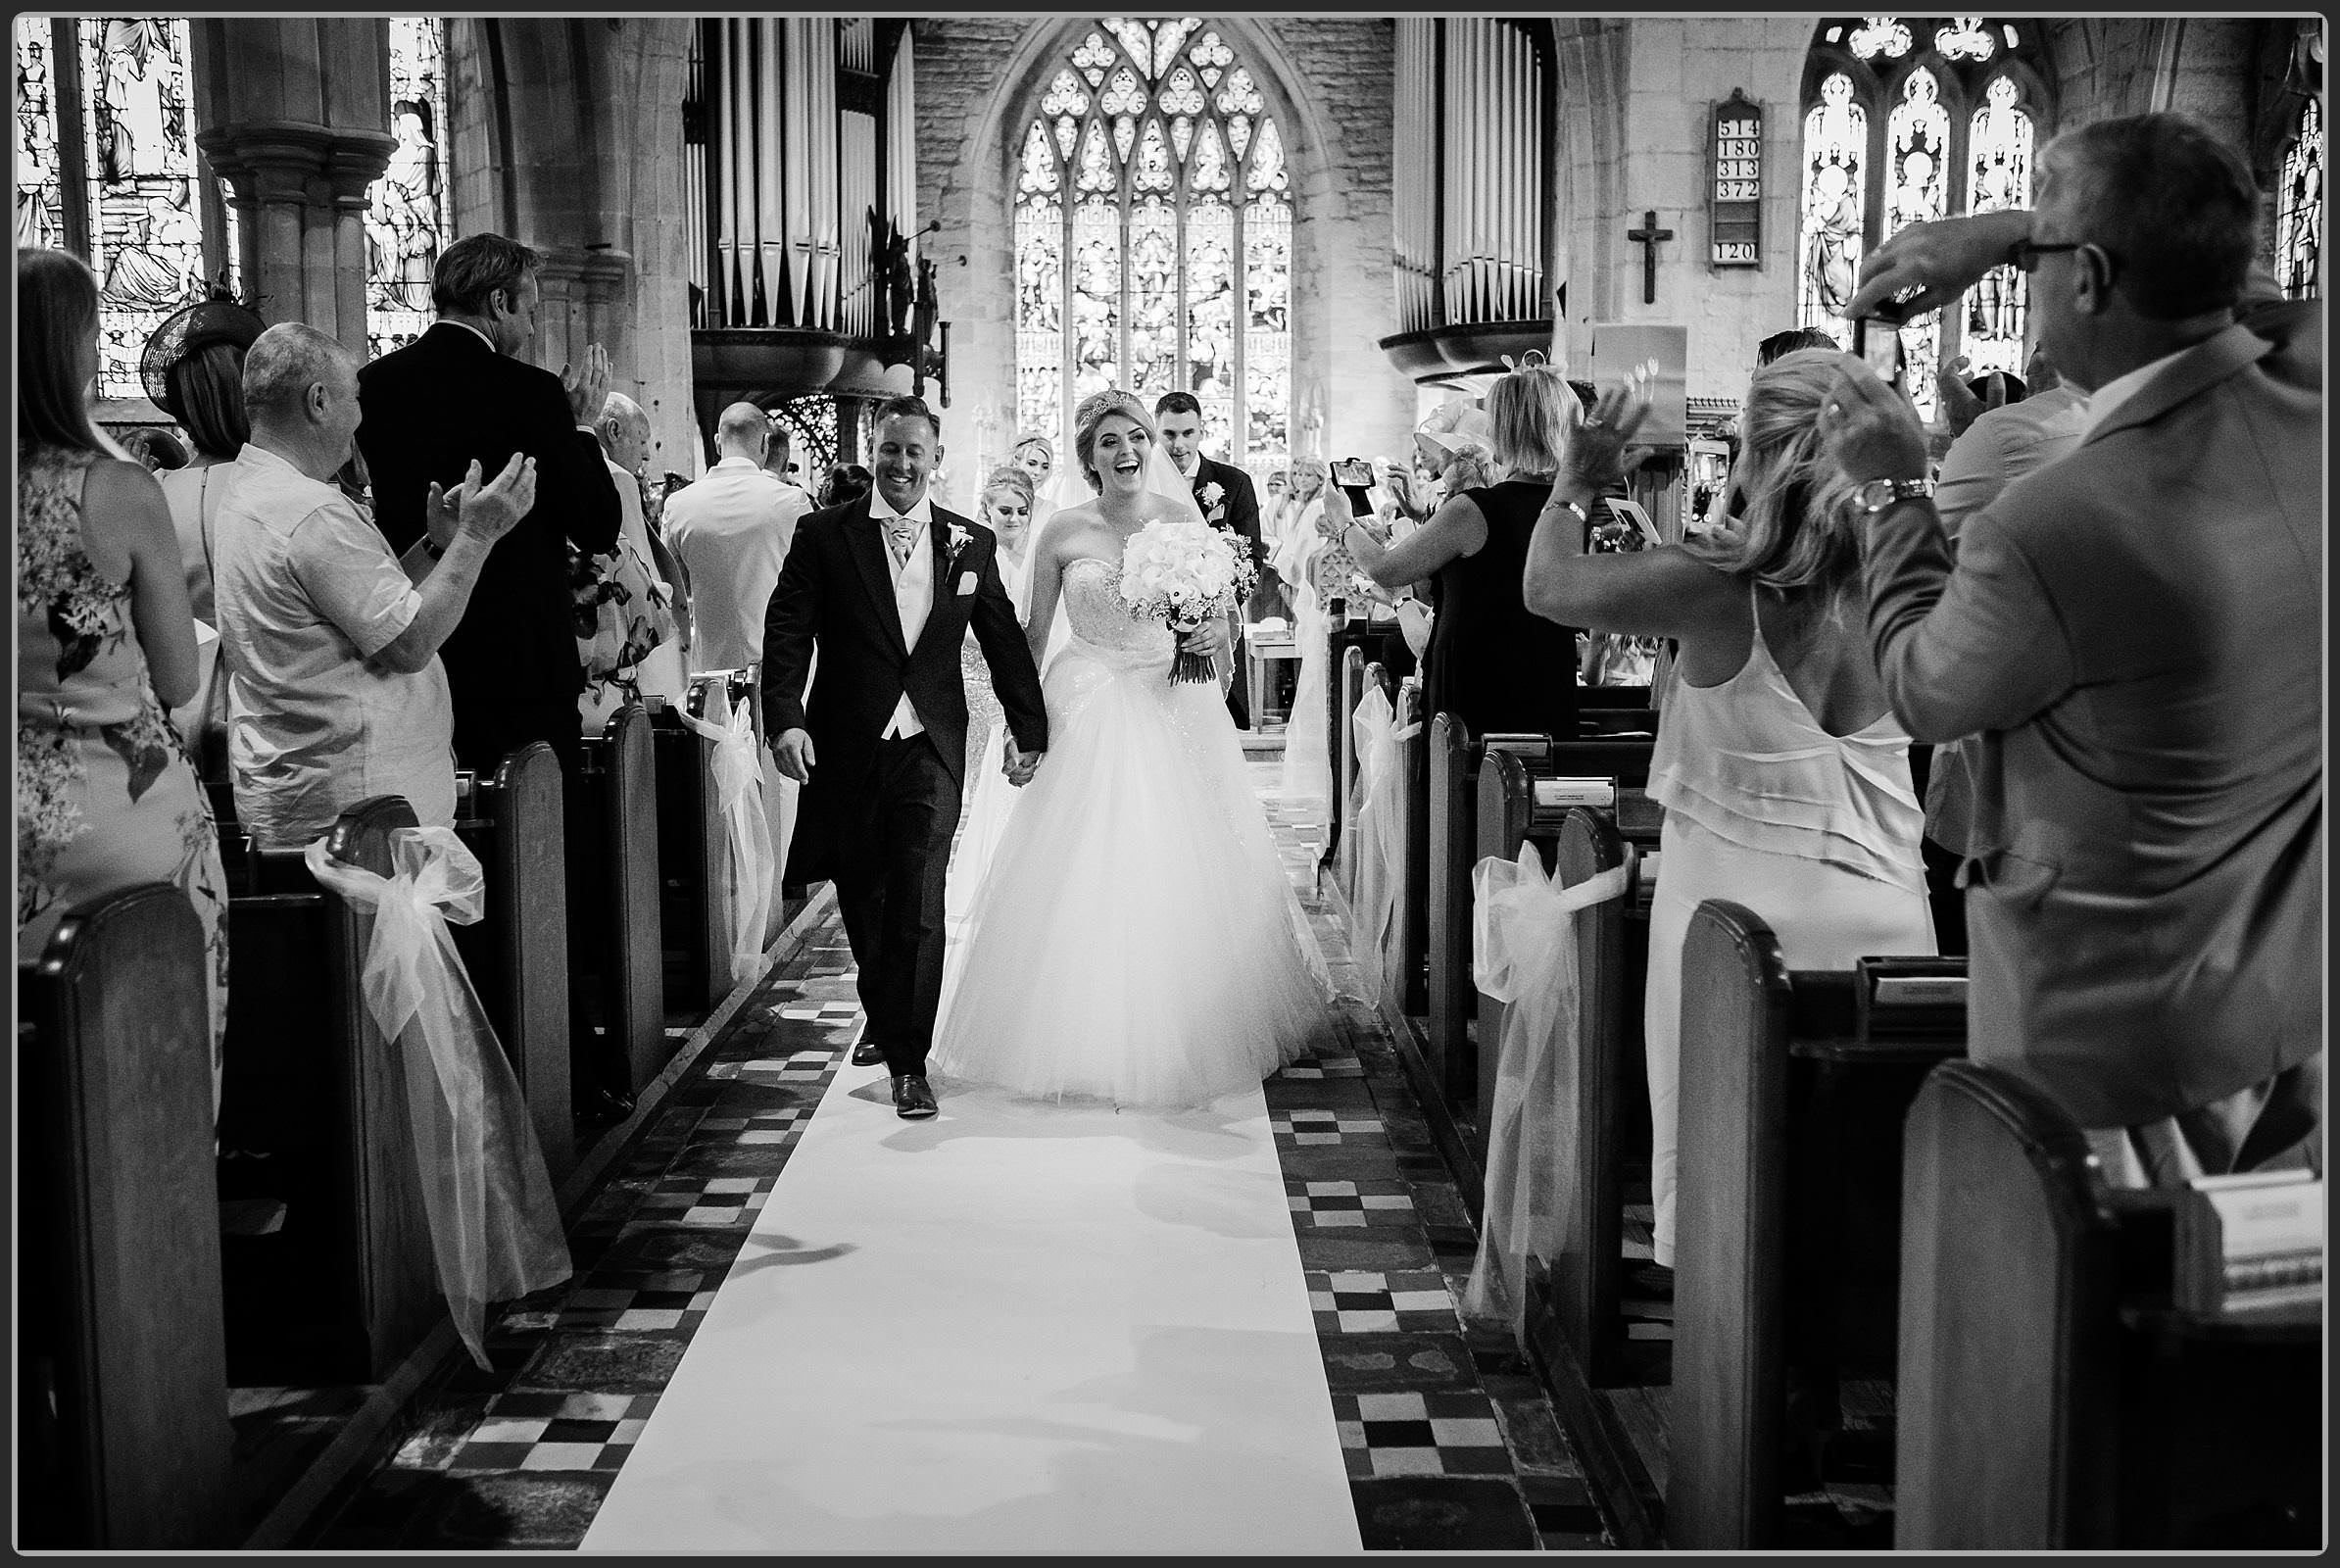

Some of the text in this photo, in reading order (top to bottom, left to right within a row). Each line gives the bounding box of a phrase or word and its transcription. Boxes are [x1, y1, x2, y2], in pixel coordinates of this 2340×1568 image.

[1721, 121, 1758, 135] 514
[1723, 140, 1759, 157] 180
[1720, 161, 1757, 176] 313
[1720, 182, 1757, 197] 372
[1717, 244, 1753, 259] 120
